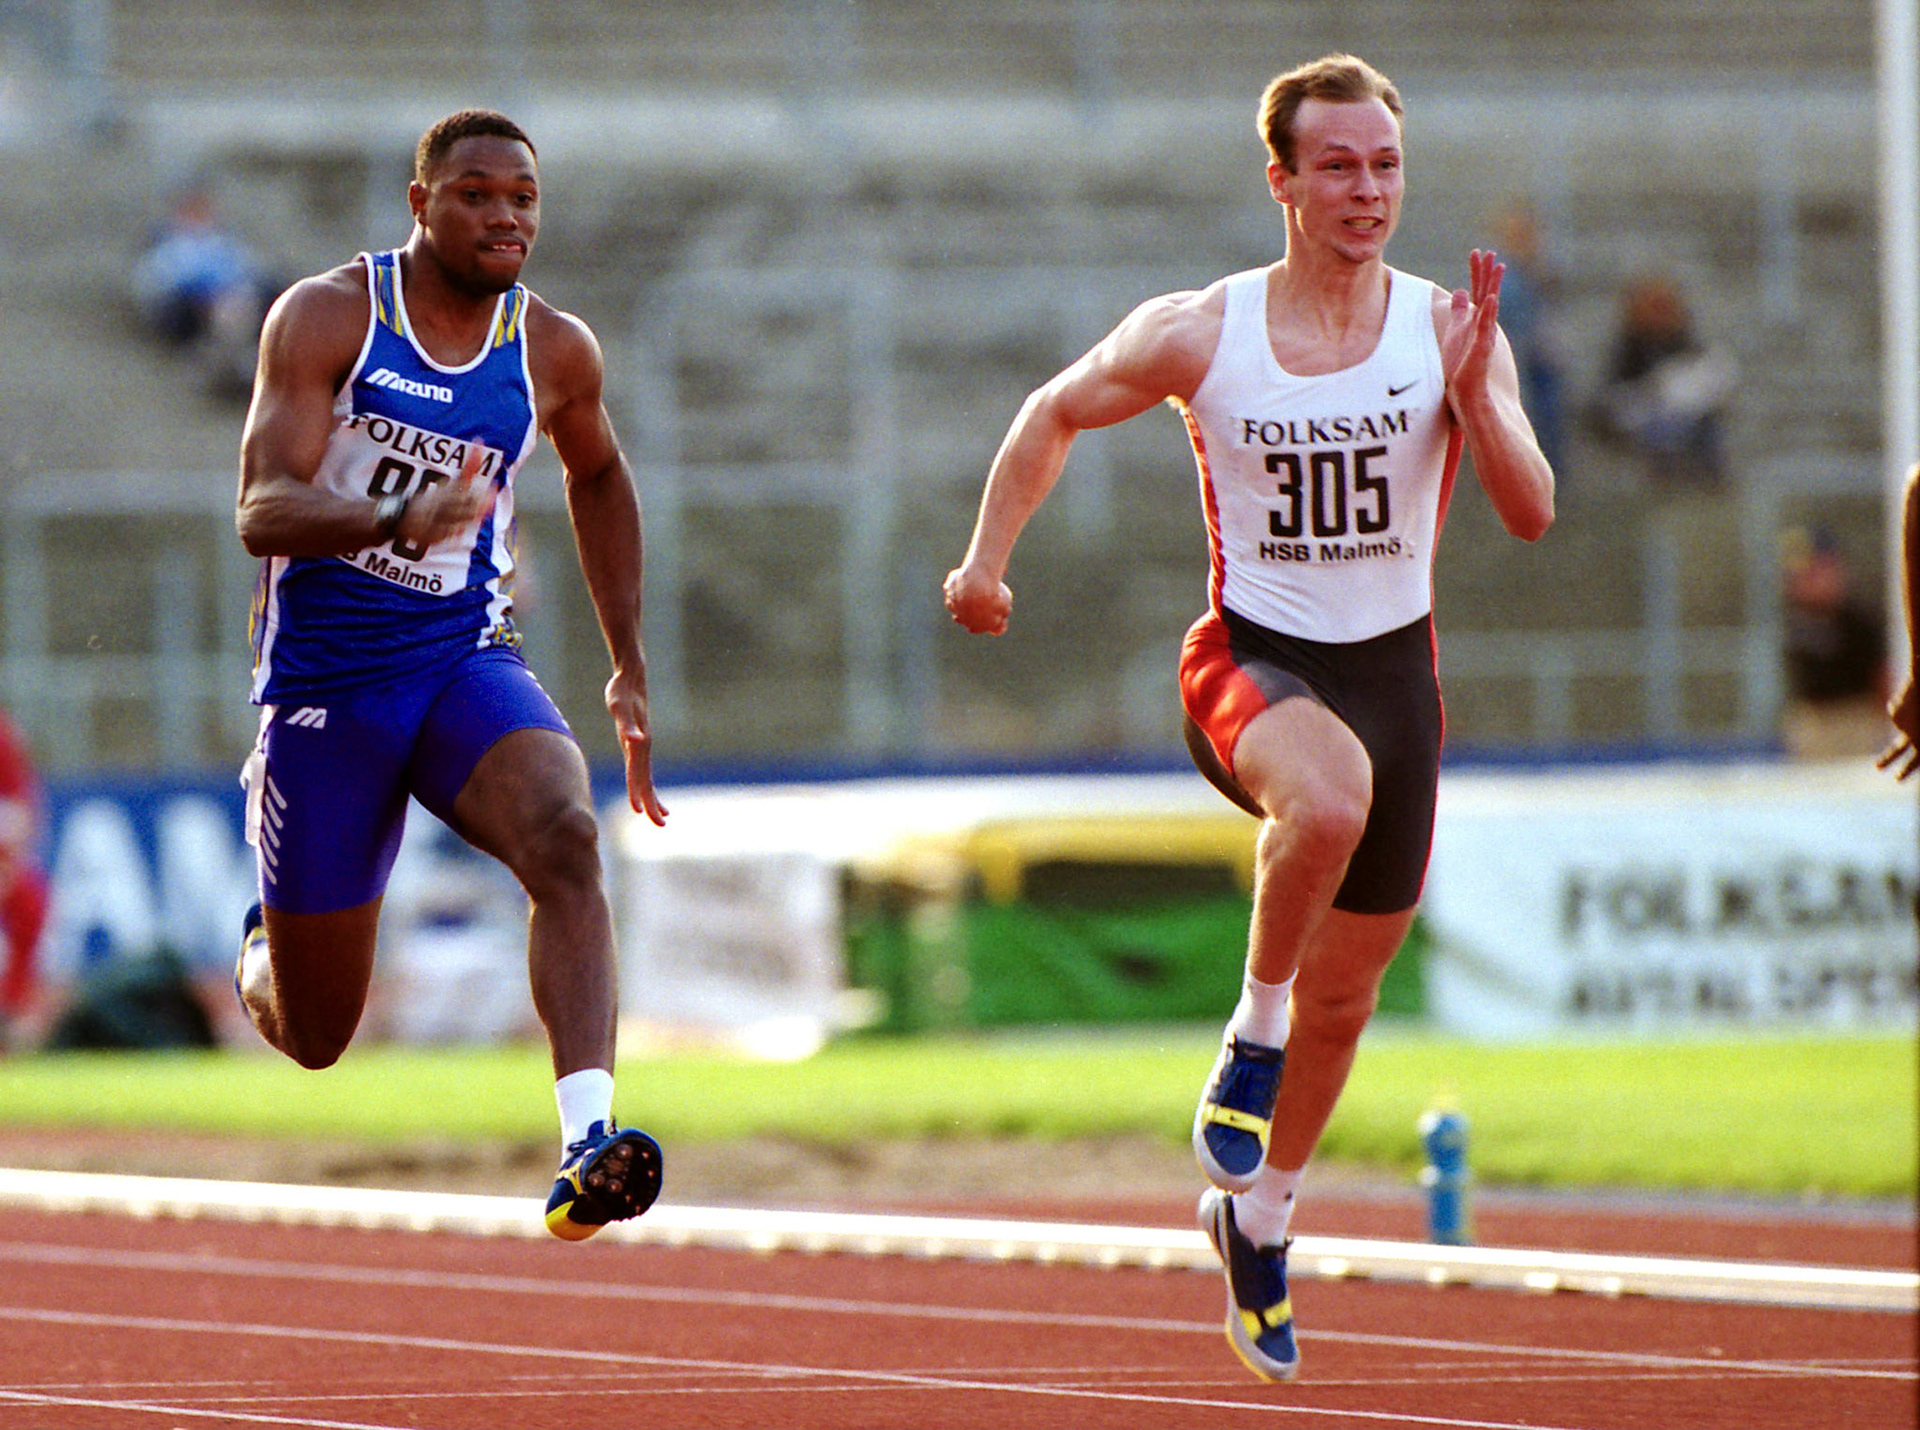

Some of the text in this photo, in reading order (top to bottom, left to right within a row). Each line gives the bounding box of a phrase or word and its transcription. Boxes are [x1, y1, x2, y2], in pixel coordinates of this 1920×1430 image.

[1243, 410, 1409, 446] FOLKSAM
[1265, 446, 1390, 538] 305
[1259, 537, 1402, 562] HSB Malmö
[364, 552, 443, 594] Malmö
